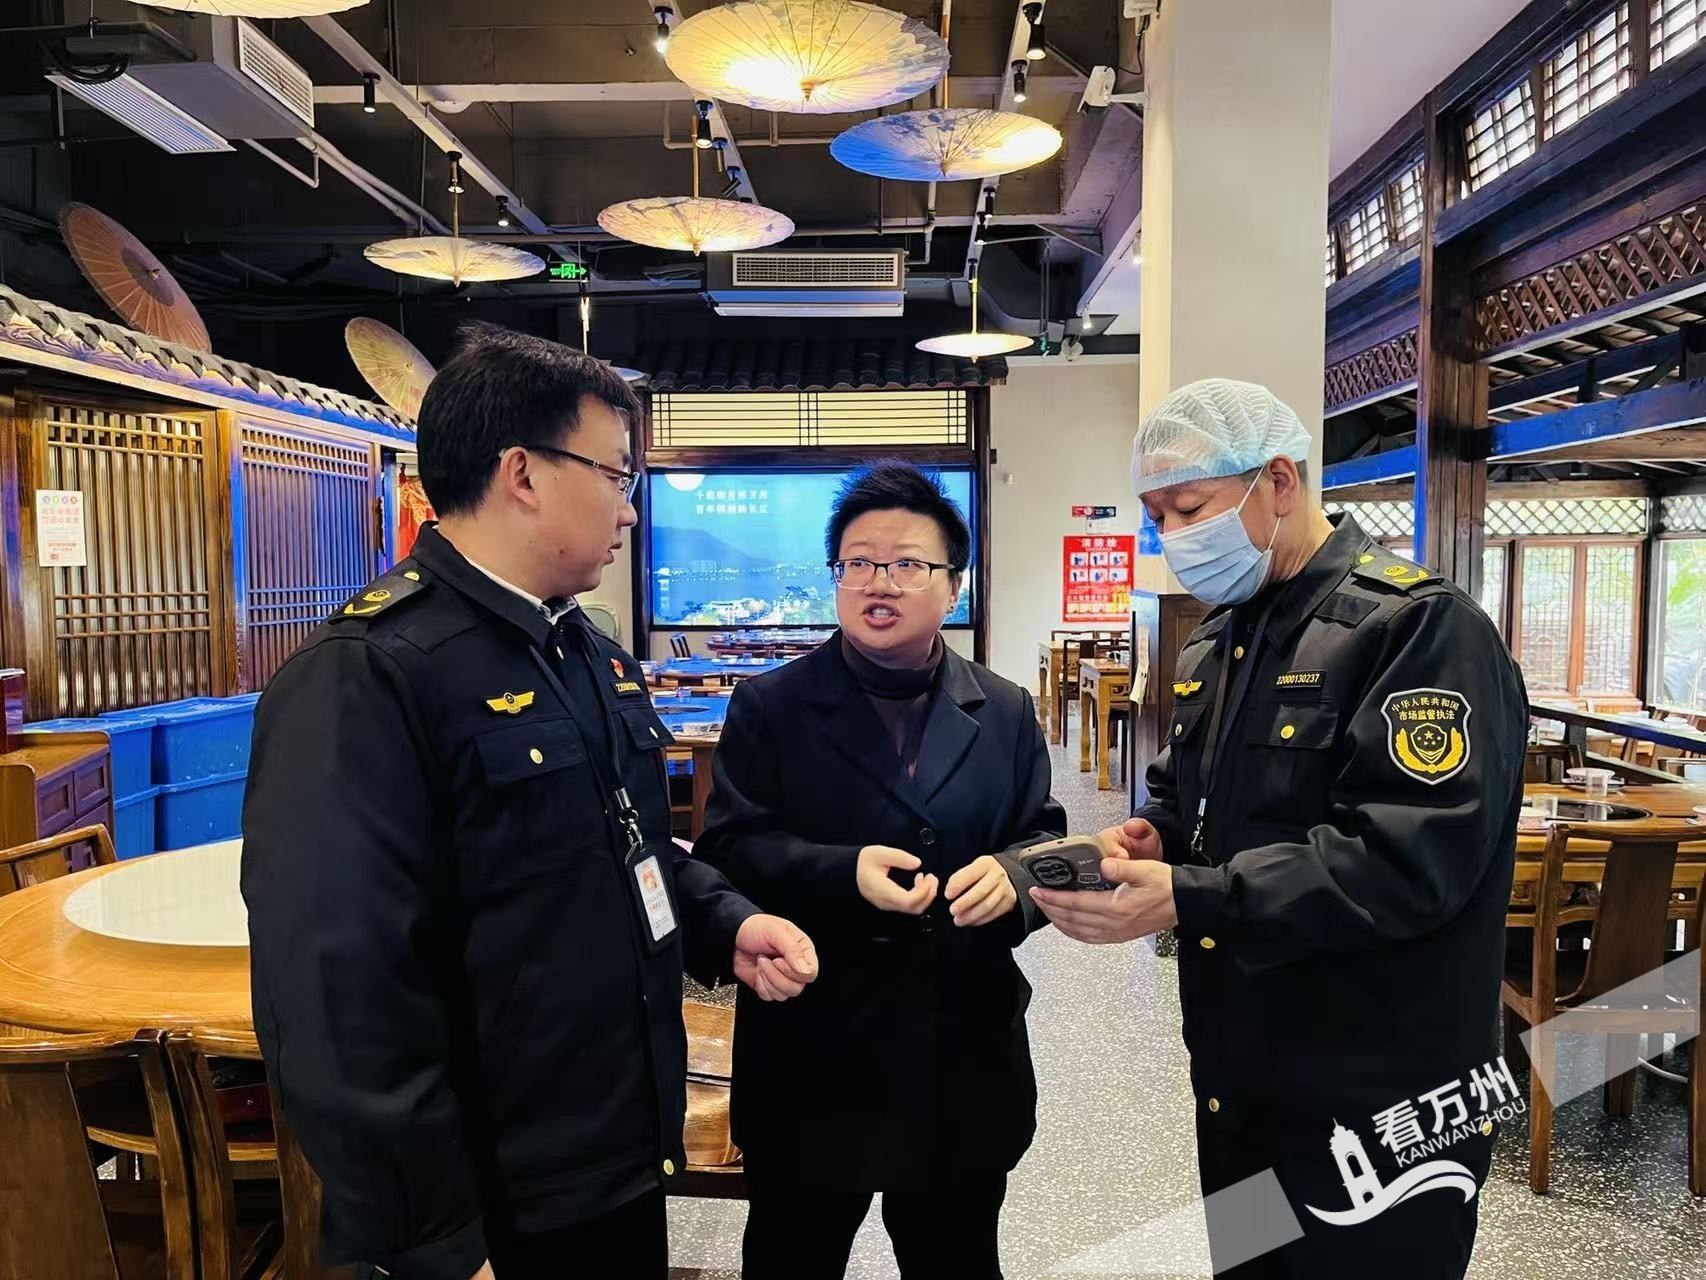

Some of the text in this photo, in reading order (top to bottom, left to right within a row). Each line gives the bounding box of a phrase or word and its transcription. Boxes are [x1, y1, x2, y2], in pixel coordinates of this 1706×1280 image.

[1391, 697, 1460, 712] 中华人民共和国
[1398, 709, 1455, 721] 市场监管执法
